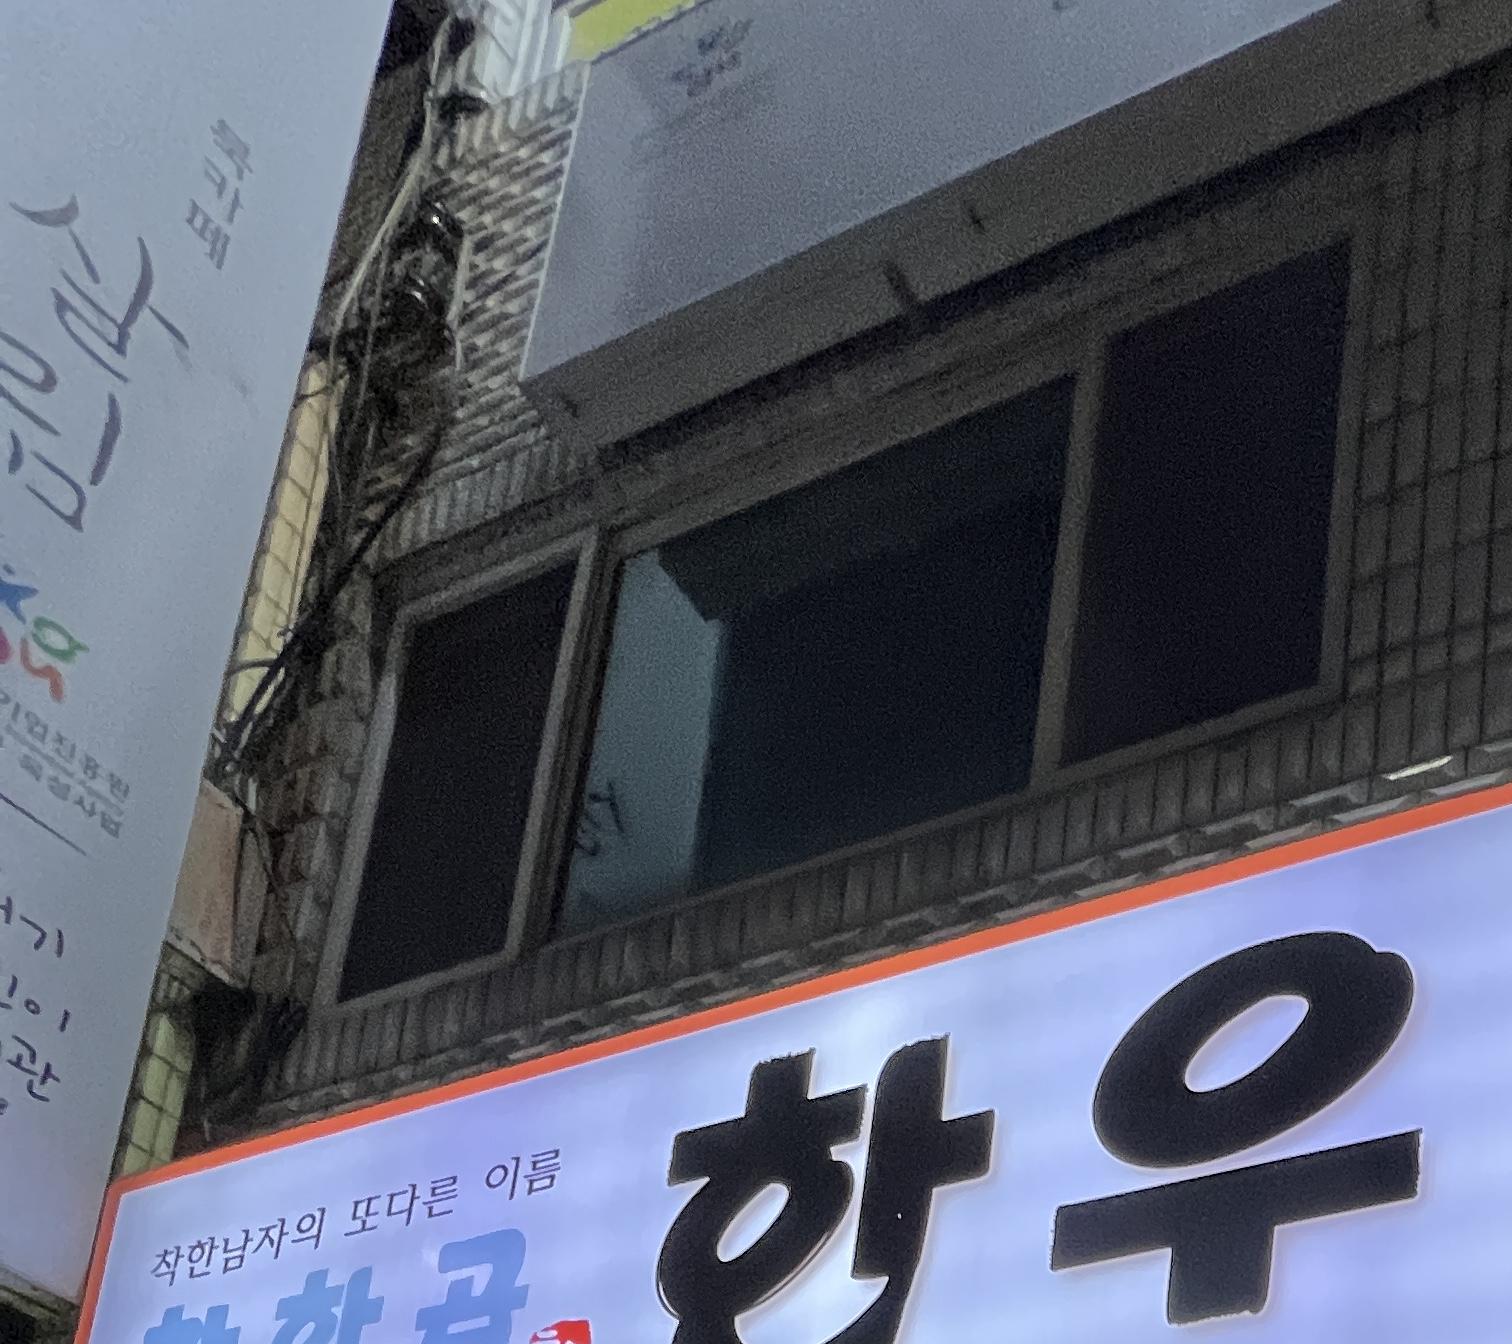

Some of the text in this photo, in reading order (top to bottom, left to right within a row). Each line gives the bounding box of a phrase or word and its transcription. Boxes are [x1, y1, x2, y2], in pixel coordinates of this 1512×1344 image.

[150, 1148, 563, 1287] 착한남자의 또다른 이름
